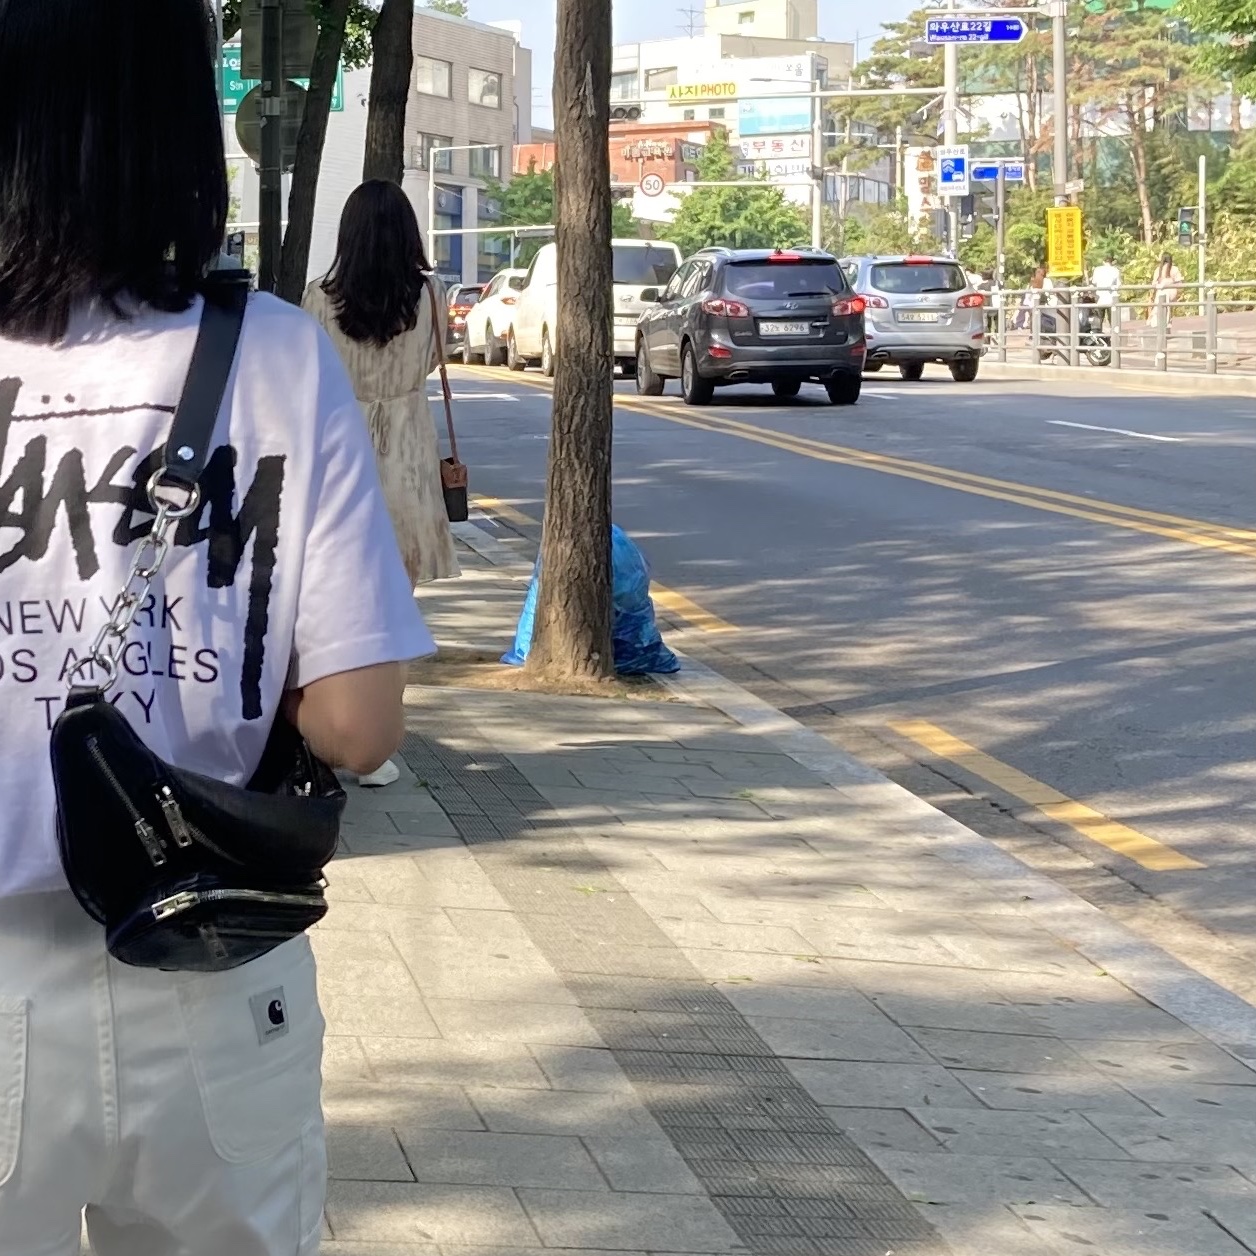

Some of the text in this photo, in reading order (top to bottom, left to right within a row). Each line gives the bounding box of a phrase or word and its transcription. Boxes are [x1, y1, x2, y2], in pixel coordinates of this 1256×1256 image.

[701, 82, 736, 96] PHOTO
[752, 138, 804, 154] 부동산
[645, 179, 659, 191] 50
[99, 592, 184, 631] YRK
